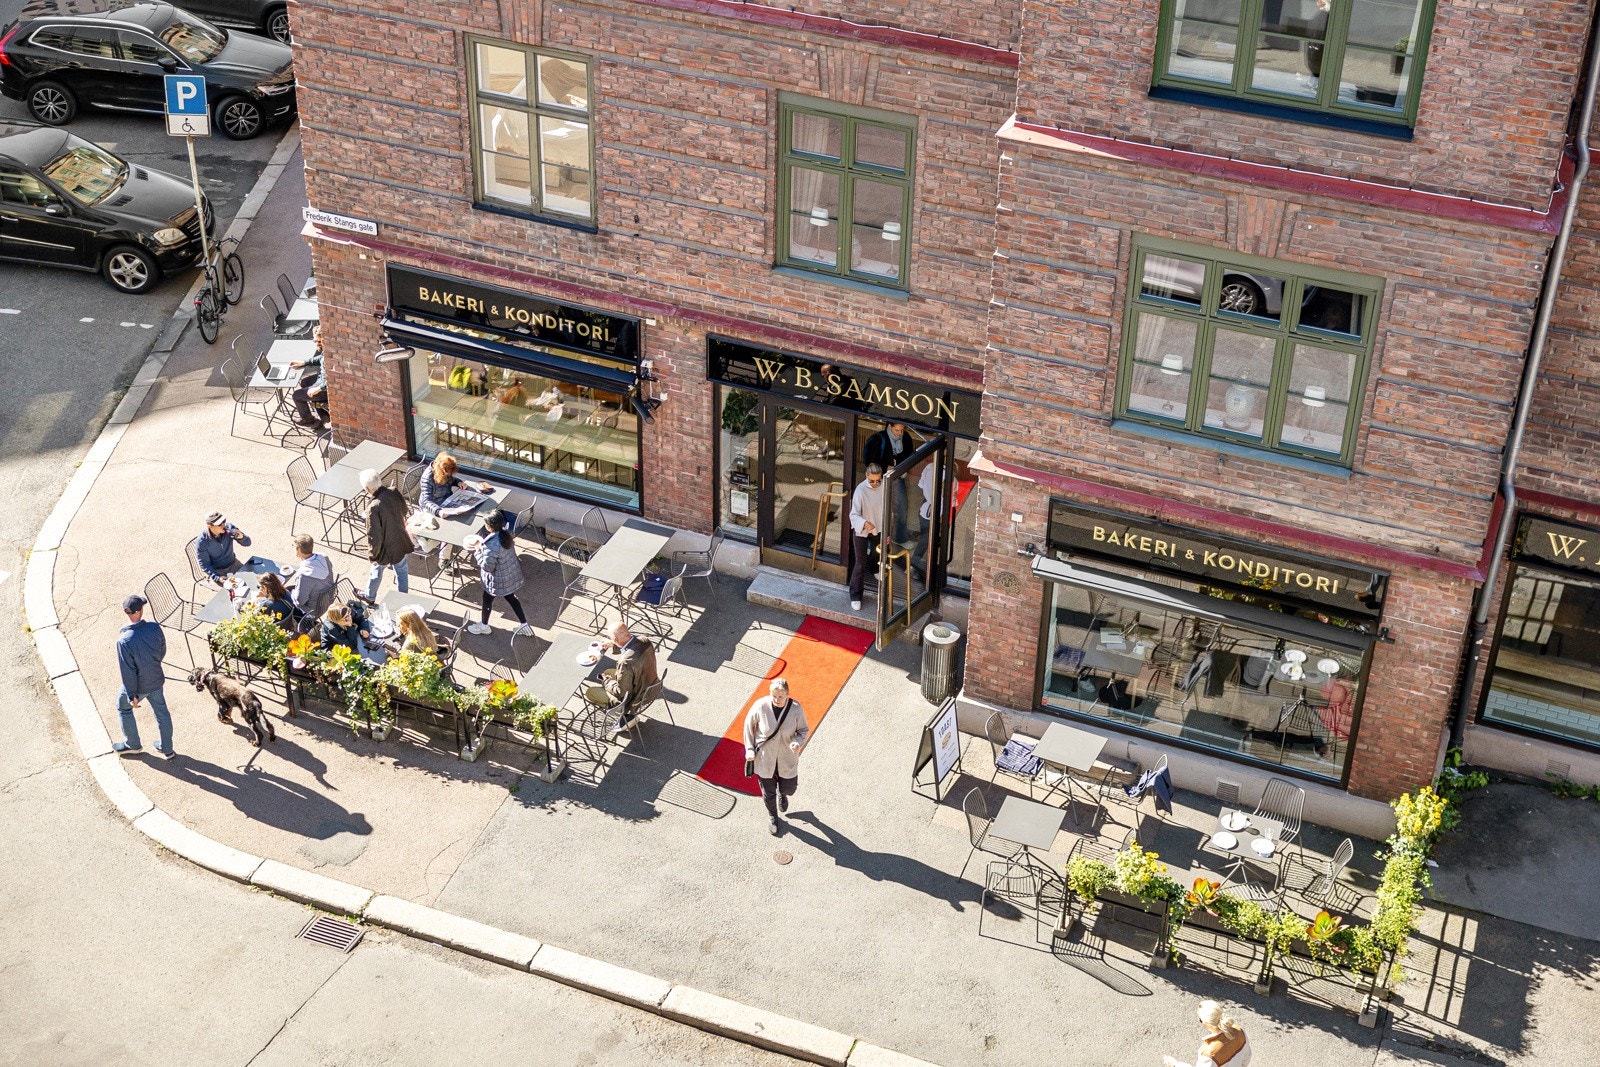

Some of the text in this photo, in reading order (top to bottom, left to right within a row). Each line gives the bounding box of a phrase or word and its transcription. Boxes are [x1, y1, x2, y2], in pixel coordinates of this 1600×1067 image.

[176, 81, 197, 110] P
[305, 211, 374, 232] Frederik Stangs gate
[419, 286, 609, 342] BAKERI & KONDITORI
[752, 356, 959, 423] W. B. SAMSON
[1092, 525, 1339, 595] BAKERI & KONDITORI
[1546, 531, 1588, 562] W.
